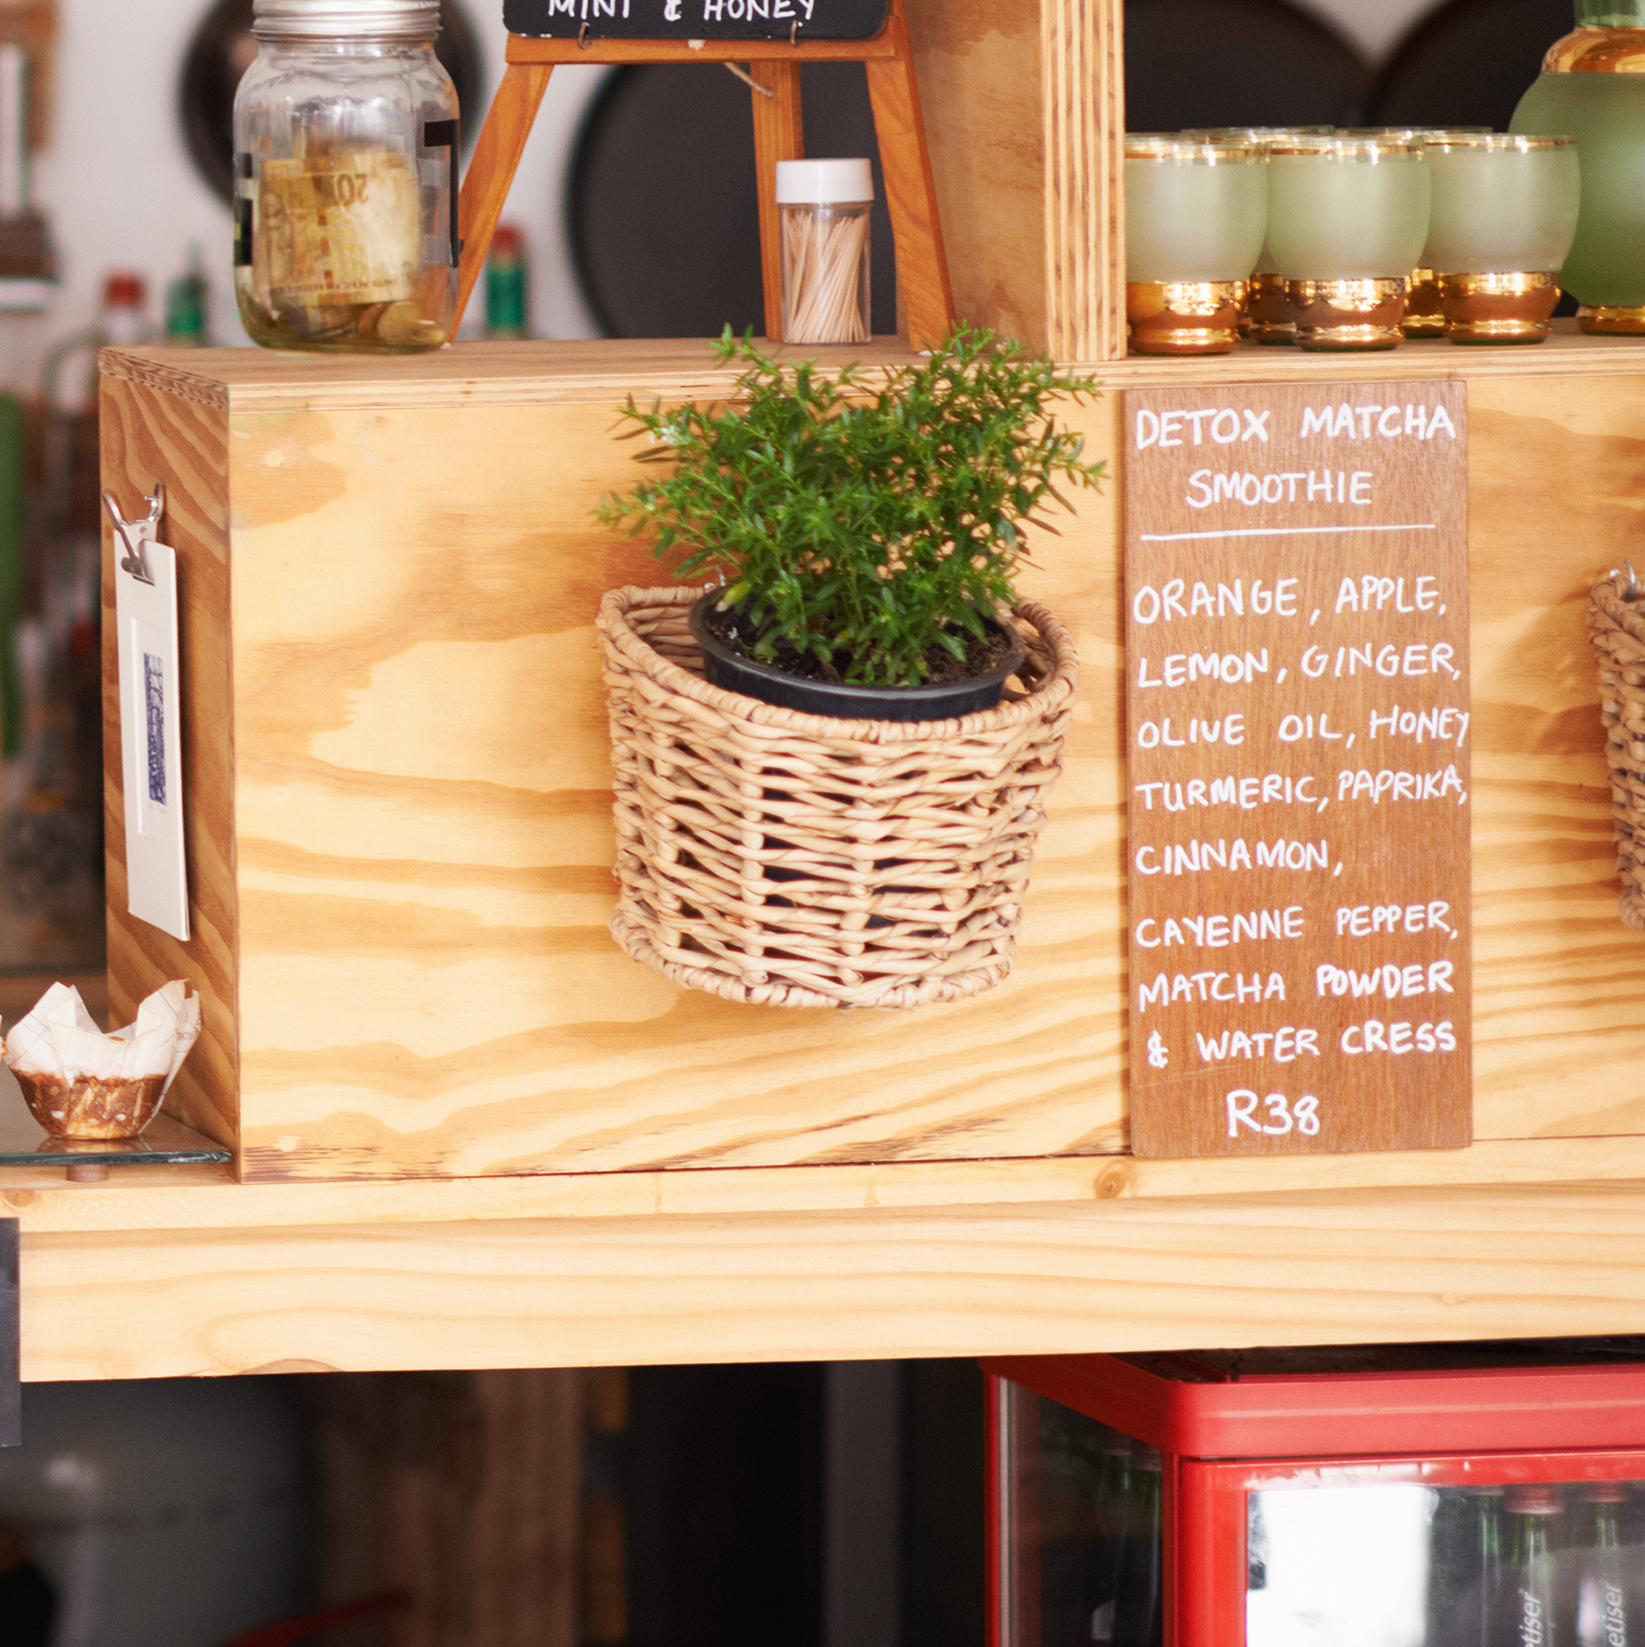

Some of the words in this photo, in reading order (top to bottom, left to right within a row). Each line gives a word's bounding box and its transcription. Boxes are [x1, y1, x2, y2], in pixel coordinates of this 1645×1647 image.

[1136, 408, 1270, 450] DETOX
[1300, 403, 1456, 440] MATCHA
[1185, 469, 1373, 508] SMOOTHIE
[1335, 575, 1446, 615] APPLE,
[1137, 648, 1287, 688] LEMON,
[1301, 642, 1460, 680] GINGER,
[1137, 714, 1244, 748] OLIVE
[1278, 713, 1355, 748] OIL,
[1369, 704, 1469, 747] HONEY
[1135, 774, 1329, 812] TURMERIC,
[1338, 764, 1467, 804] PAPRIKA,
[1135, 838, 1342, 876] CINNAMON,
[1135, 906, 1304, 947] CAYENNE
[1336, 901, 1458, 939] PEPPER,
[1138, 971, 1285, 1012] MATCHA
[1316, 960, 1453, 999] POWDER
[1147, 1030, 1168, 1068] &
[1196, 1027, 1320, 1063] WATER
[1341, 1019, 1456, 1054] CRESS
[1226, 1089, 1320, 1137] R38
